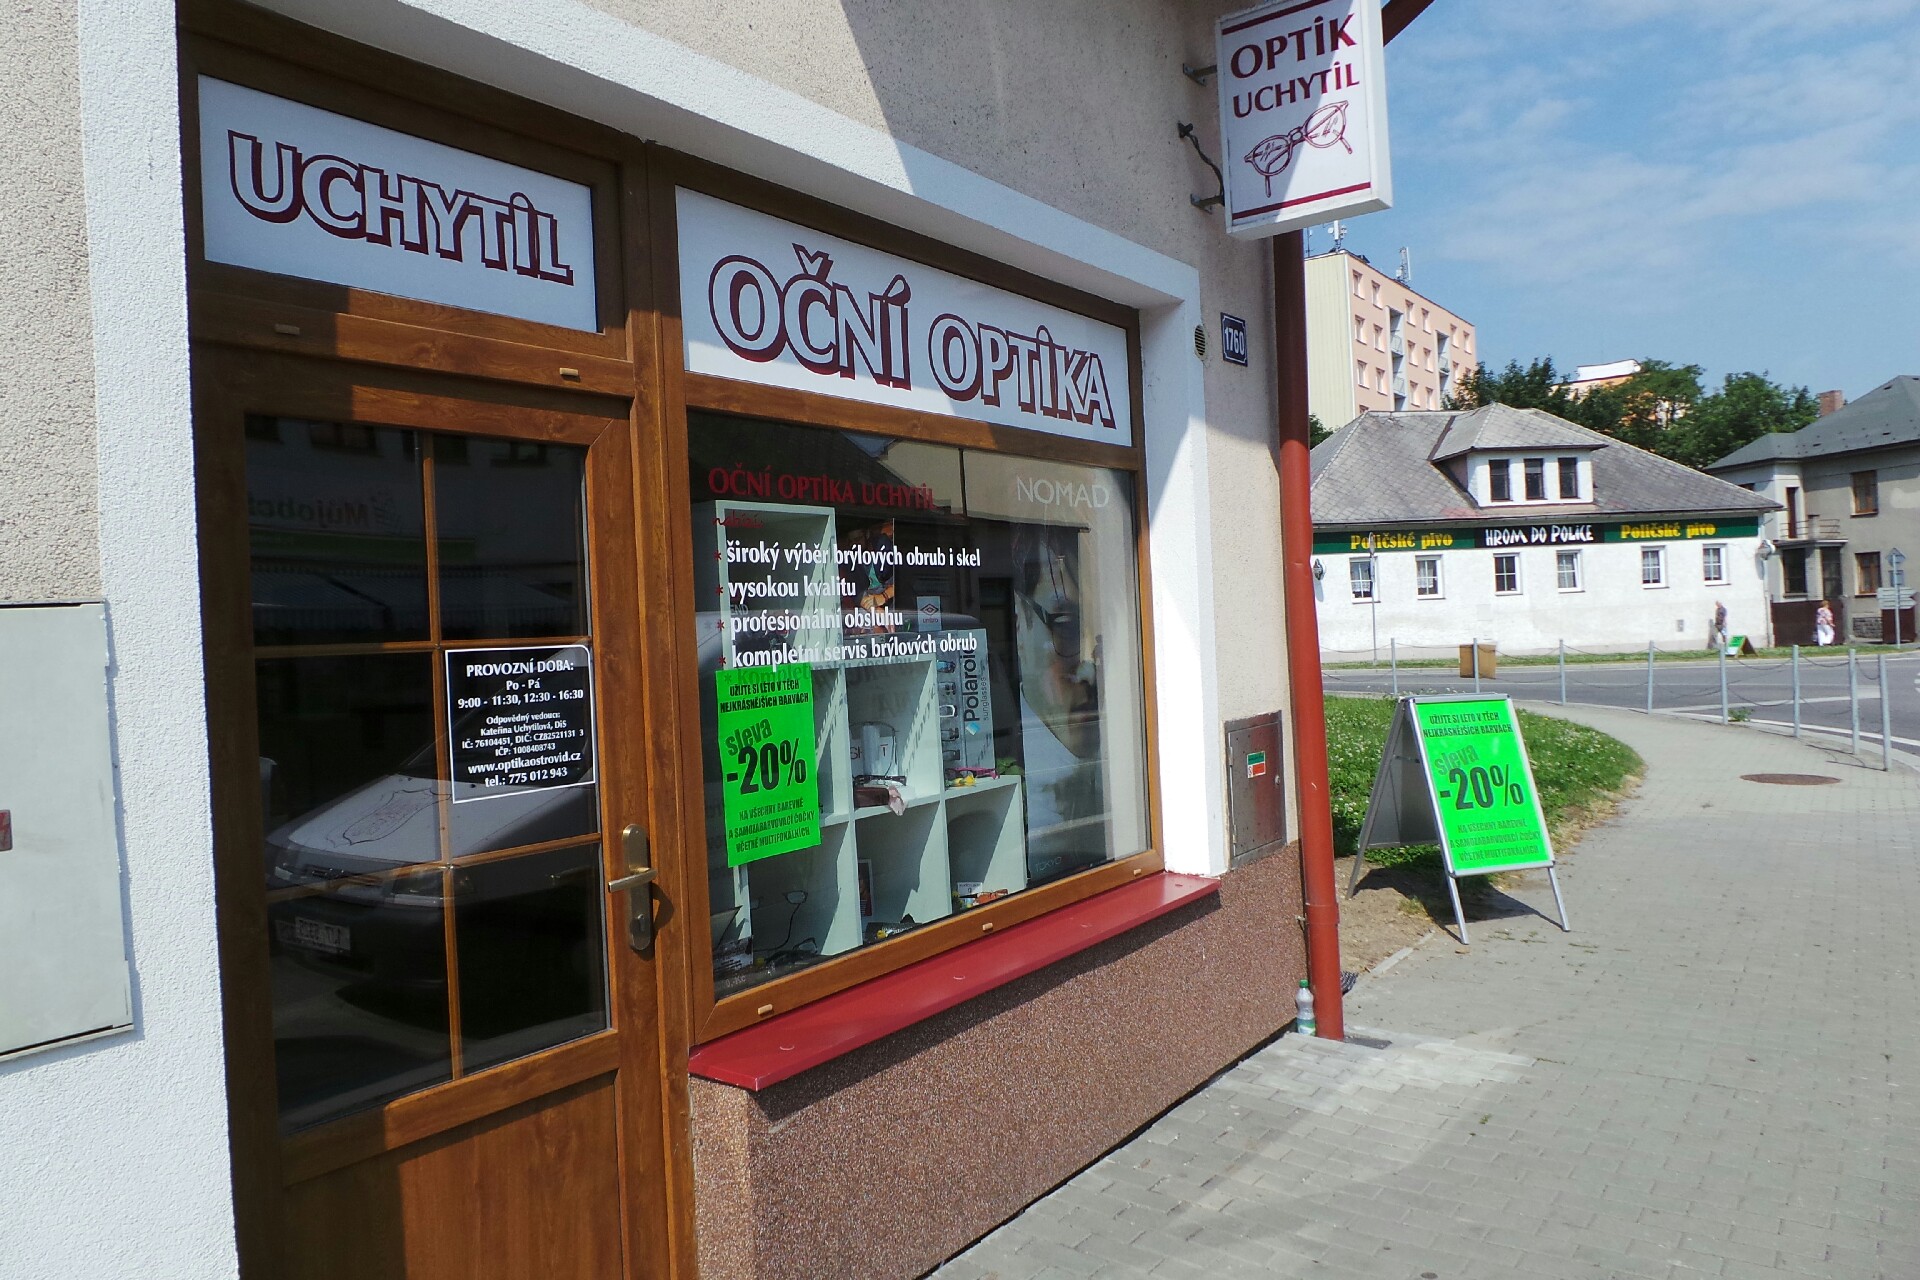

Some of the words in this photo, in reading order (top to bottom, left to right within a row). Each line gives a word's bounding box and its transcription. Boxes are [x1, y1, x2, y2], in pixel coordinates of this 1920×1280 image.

[708, 243, 911, 390] OČNÍ
[1223, 326, 1245, 356] 1760
[708, 463, 772, 497] OČNÍ
[1016, 475, 1110, 508] NOMAD
[1485, 528, 1528, 546] HROM
[1531, 526, 1547, 543] DO
[1686, 522, 1716, 538] pivo
[1421, 532, 1453, 549] pivo
[726, 540, 780, 570] široký
[784, 542, 829, 570] výběr
[833, 543, 903, 571] brýlových
[906, 545, 946, 566] obrub
[949, 547, 953, 566] i
[956, 547, 981, 567] skel
[728, 575, 799, 605] vysokou
[803, 575, 856, 597] kvalitu
[731, 608, 841, 640] profesionální
[844, 606, 903, 628] obsluhu
[732, 641, 819, 672] kompletní
[824, 639, 868, 661] servis
[871, 634, 936, 662] brýlových
[940, 632, 978, 652] obrub
[466, 658, 534, 677] PROVOZNÍ
[537, 659, 574, 672] DOBA:
[506, 680, 519, 690] Po
[528, 678, 540, 689] Pá
[729, 684, 751, 696] UŽIJTE
[752, 683, 759, 694] SI
[760, 680, 776, 693] LÉTO
[775, 681, 781, 691] V
[782, 678, 800, 690] TĚCH
[458, 697, 480, 708] 9:00
[492, 694, 521, 705] 11:30,
[523, 692, 550, 703] 12:30
[559, 689, 584, 700] 16:30
[779, 691, 809, 706] BARVÁCH
[486, 713, 529, 725] Odpovědný
[1452, 714, 1460, 723] SI
[1476, 712, 1482, 722] V
[1482, 710, 1500, 721] TĚCH
[480, 726, 512, 736] Kateřina
[513, 722, 553, 733] Uchytilová,
[554, 720, 567, 729] DiS
[724, 718, 773, 756] sleva
[461, 738, 474, 749] IČ:
[515, 733, 532, 744] DIČ:
[495, 746, 511, 756] IČP:
[467, 751, 582, 774] www.optikaostrovid.cz
[726, 738, 807, 795] -20%
[1434, 744, 1479, 775] sleva
[485, 776, 506, 788] tel.:
[508, 772, 527, 784] 775
[529, 770, 548, 781] 012
[549, 766, 568, 779] 943
[1439, 764, 1524, 810] -20%
[739, 809, 749, 820] NA
[728, 829, 734, 839] A
